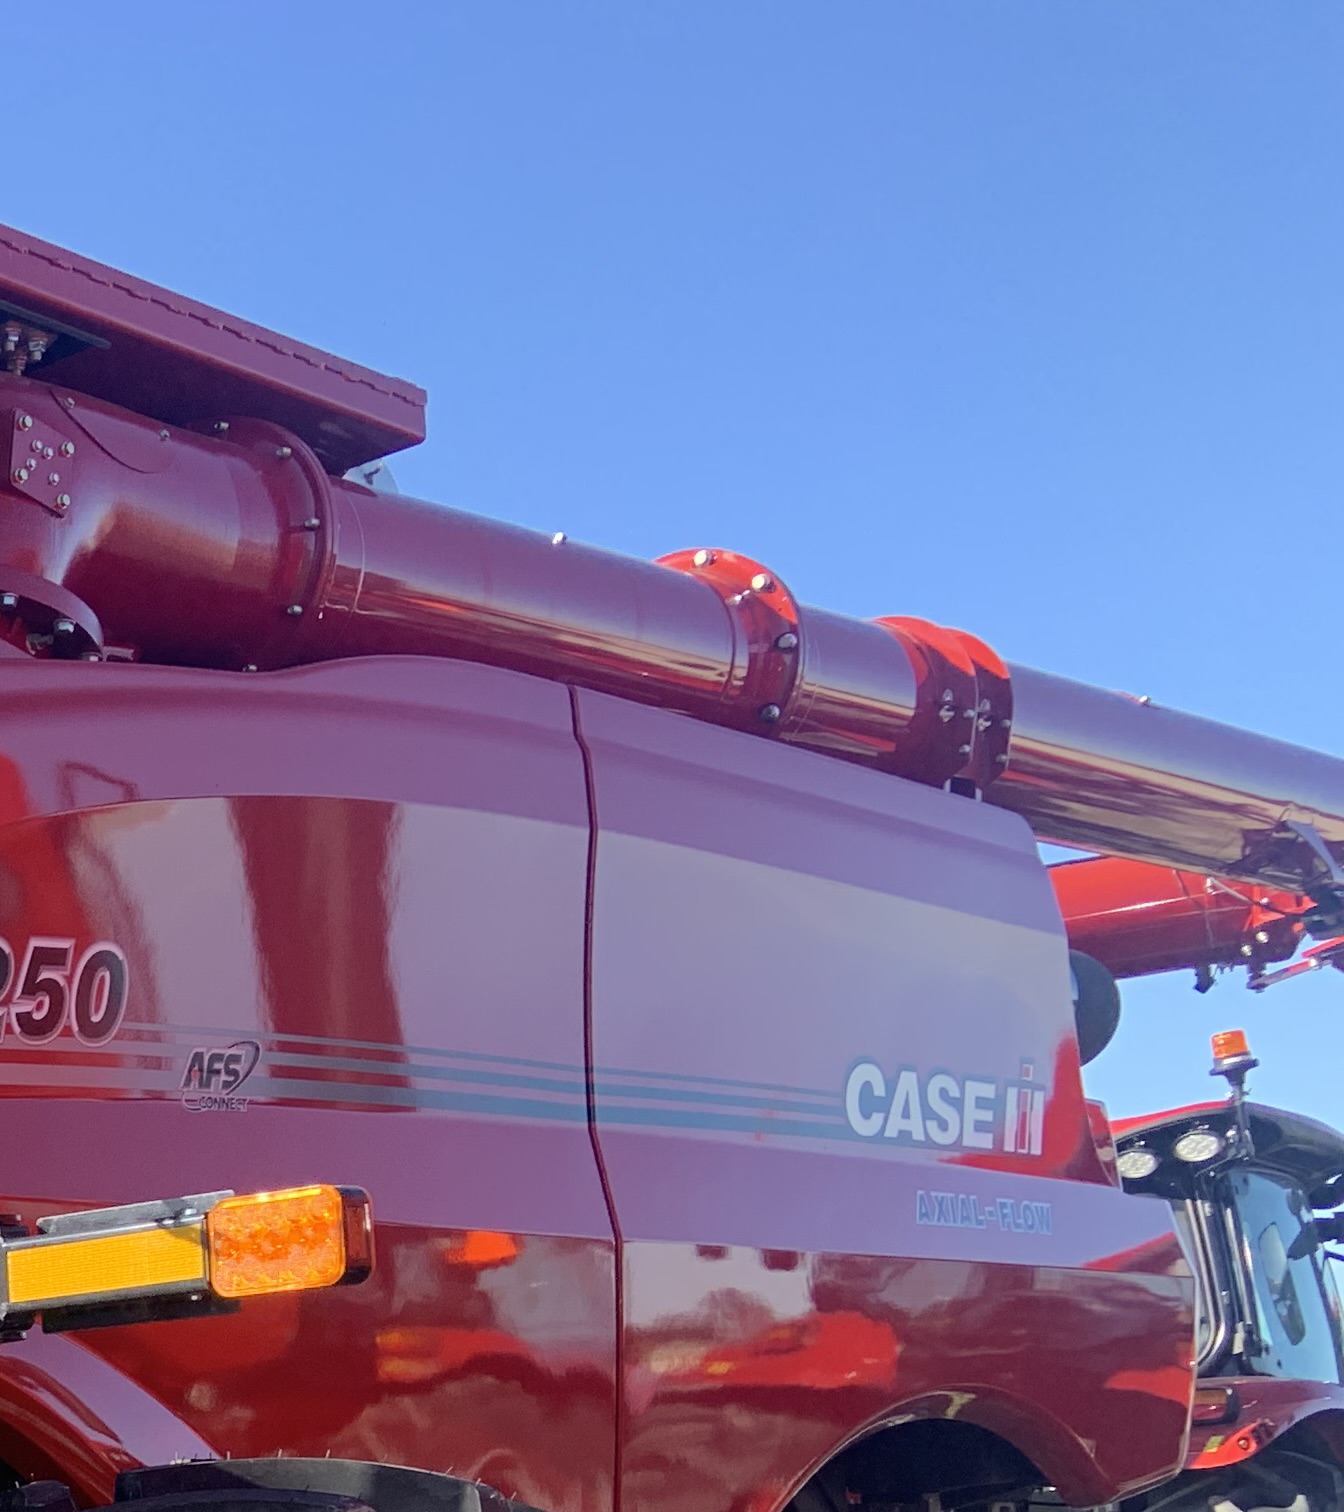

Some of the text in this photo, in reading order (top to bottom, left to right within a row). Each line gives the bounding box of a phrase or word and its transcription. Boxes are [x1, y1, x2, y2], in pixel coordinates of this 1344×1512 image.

[180, 1049, 246, 1092] AFS
[199, 1095, 248, 1111] CONNECT
[845, 1062, 996, 1150] CASE
[916, 1189, 1054, 1236] AXIAL-FLOW
